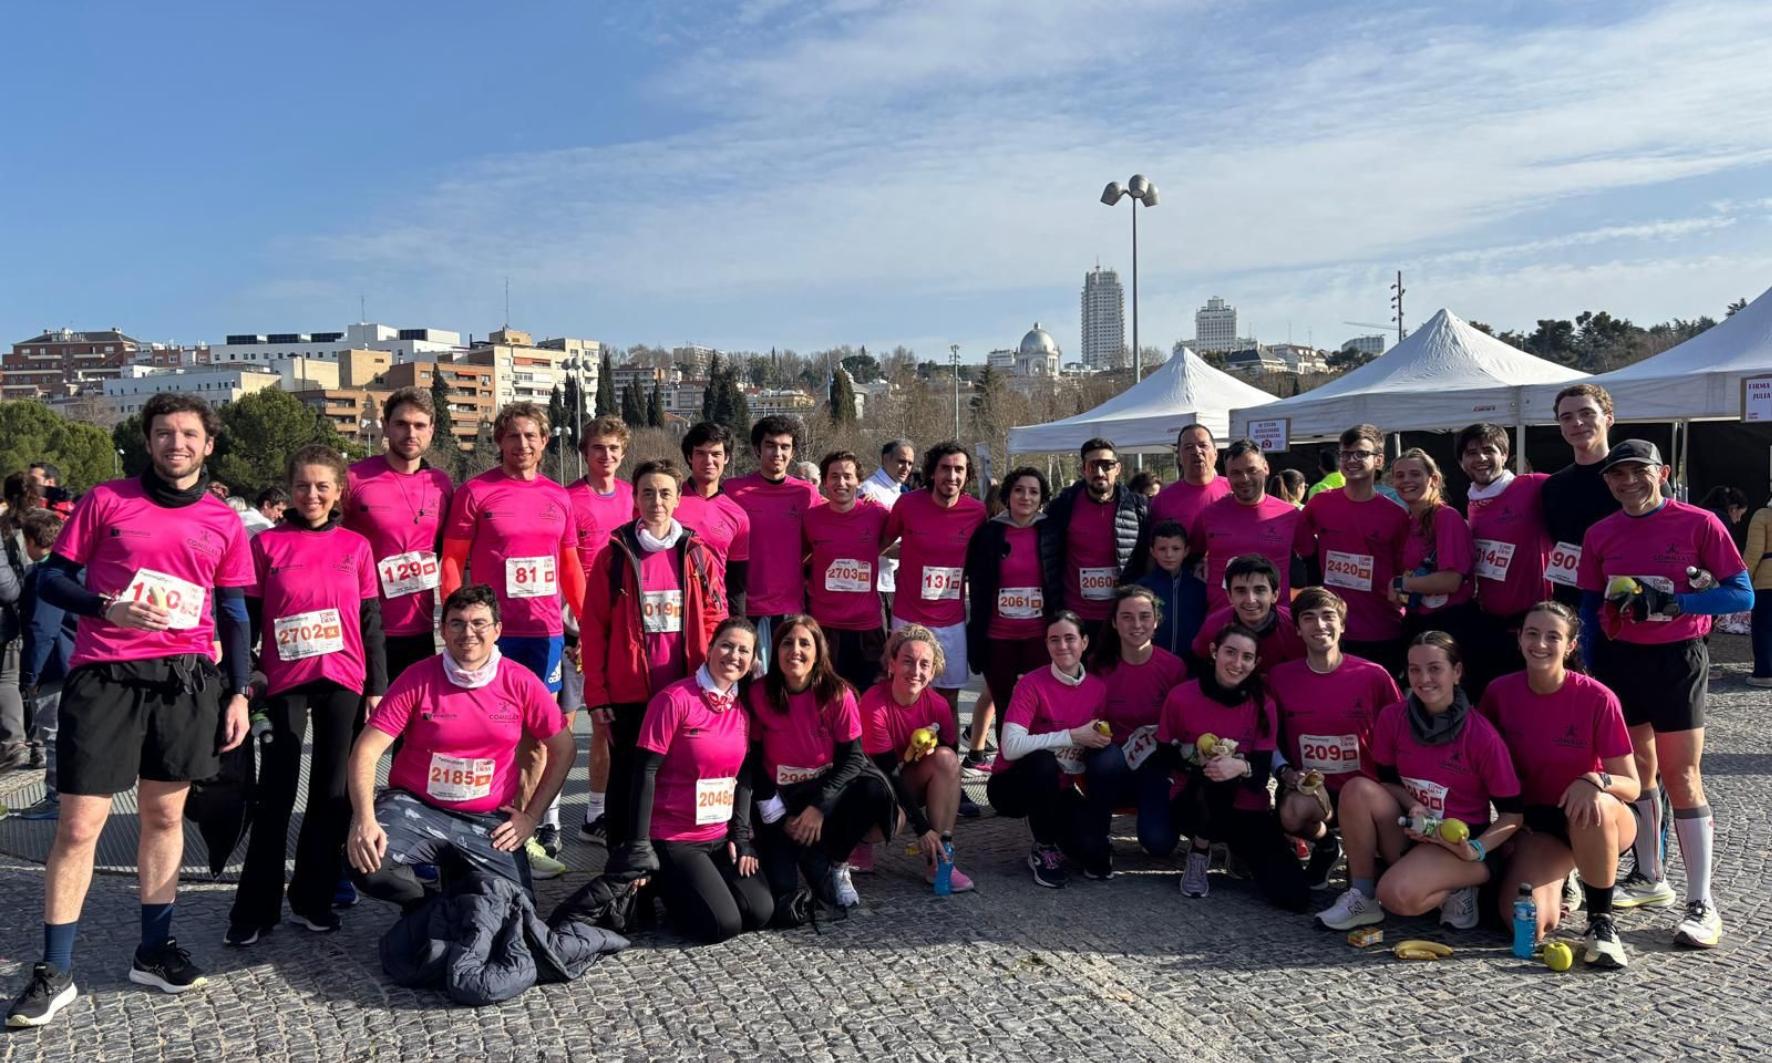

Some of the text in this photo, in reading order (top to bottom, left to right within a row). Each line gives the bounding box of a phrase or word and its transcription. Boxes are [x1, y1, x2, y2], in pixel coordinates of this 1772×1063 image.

[1327, 559, 1359, 576] 2420
[1551, 551, 1578, 570] 90
[384, 561, 422, 584] 129
[515, 567, 537, 584] 81
[828, 567, 858, 580] 2703
[926, 574, 951, 590] 131
[1082, 576, 1113, 588] 2060
[643, 602, 673, 617] 019
[1000, 596, 1031, 608] 2061
[278, 623, 324, 645] 2702
[1303, 743, 1341, 761] 209
[431, 766, 475, 786] 2185
